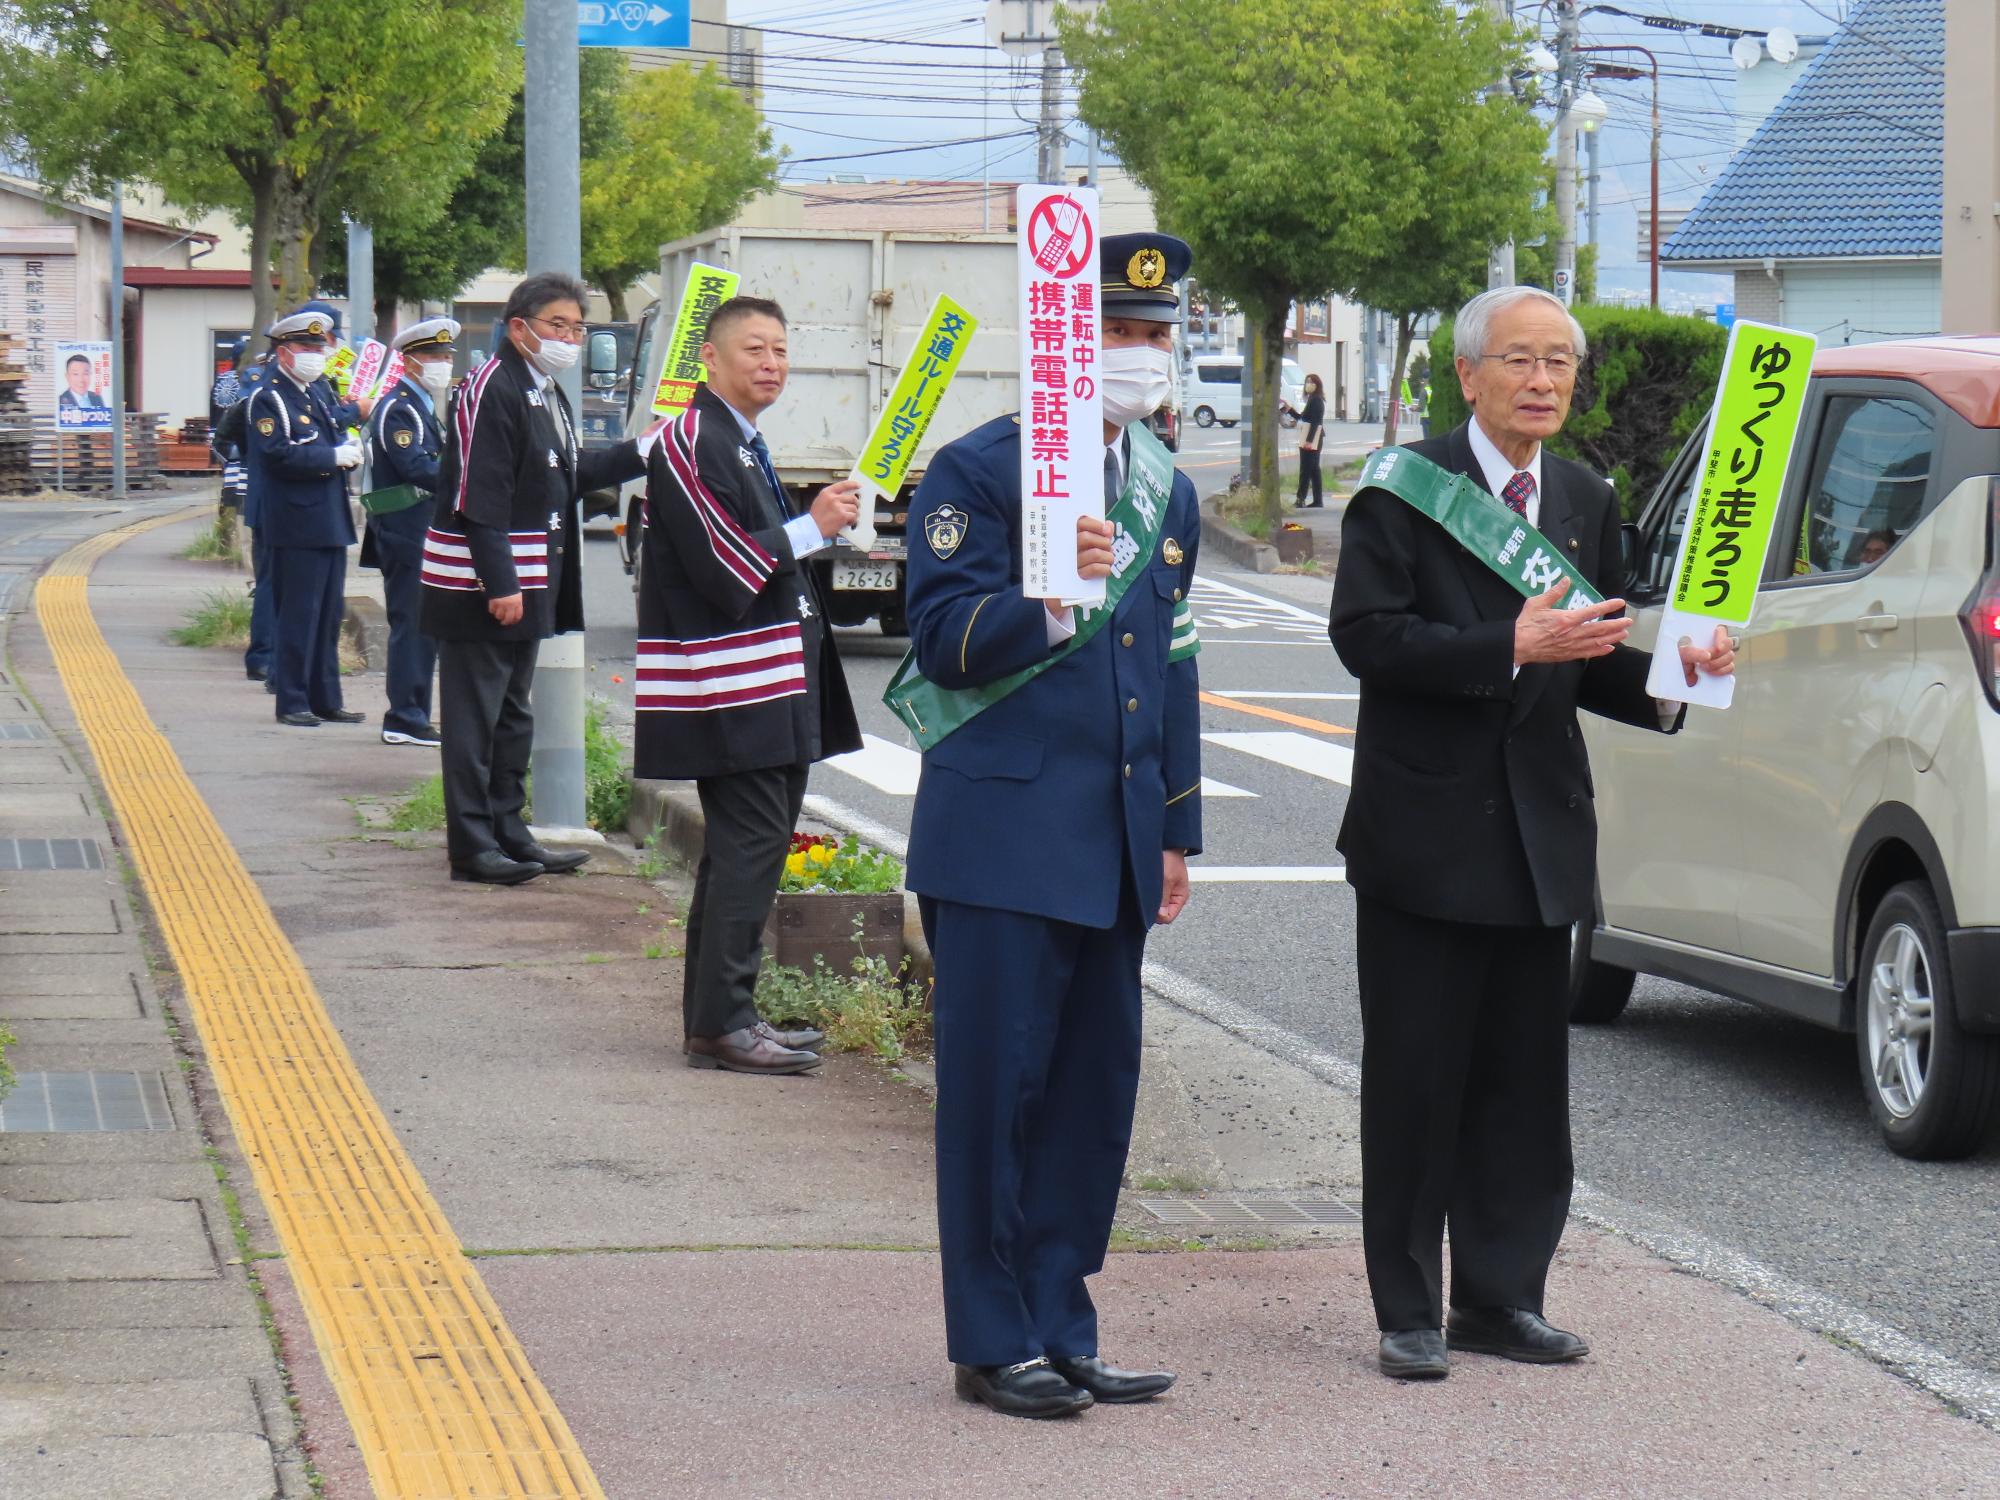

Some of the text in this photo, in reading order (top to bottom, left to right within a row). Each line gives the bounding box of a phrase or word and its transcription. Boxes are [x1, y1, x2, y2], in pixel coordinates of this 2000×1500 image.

[624, 6, 642, 21] 20
[1071, 283, 1095, 401] 運転中の
[874, 311, 966, 480] 交通ルール守ろう
[1029, 281, 1070, 498] 携帯電話禁止
[1372, 451, 1399, 482] 甲斐市
[1701, 342, 1791, 607] ゆっくり走ろう
[847, 571, 893, 588] 26-26
[1497, 525, 1527, 566] 甲斐市
